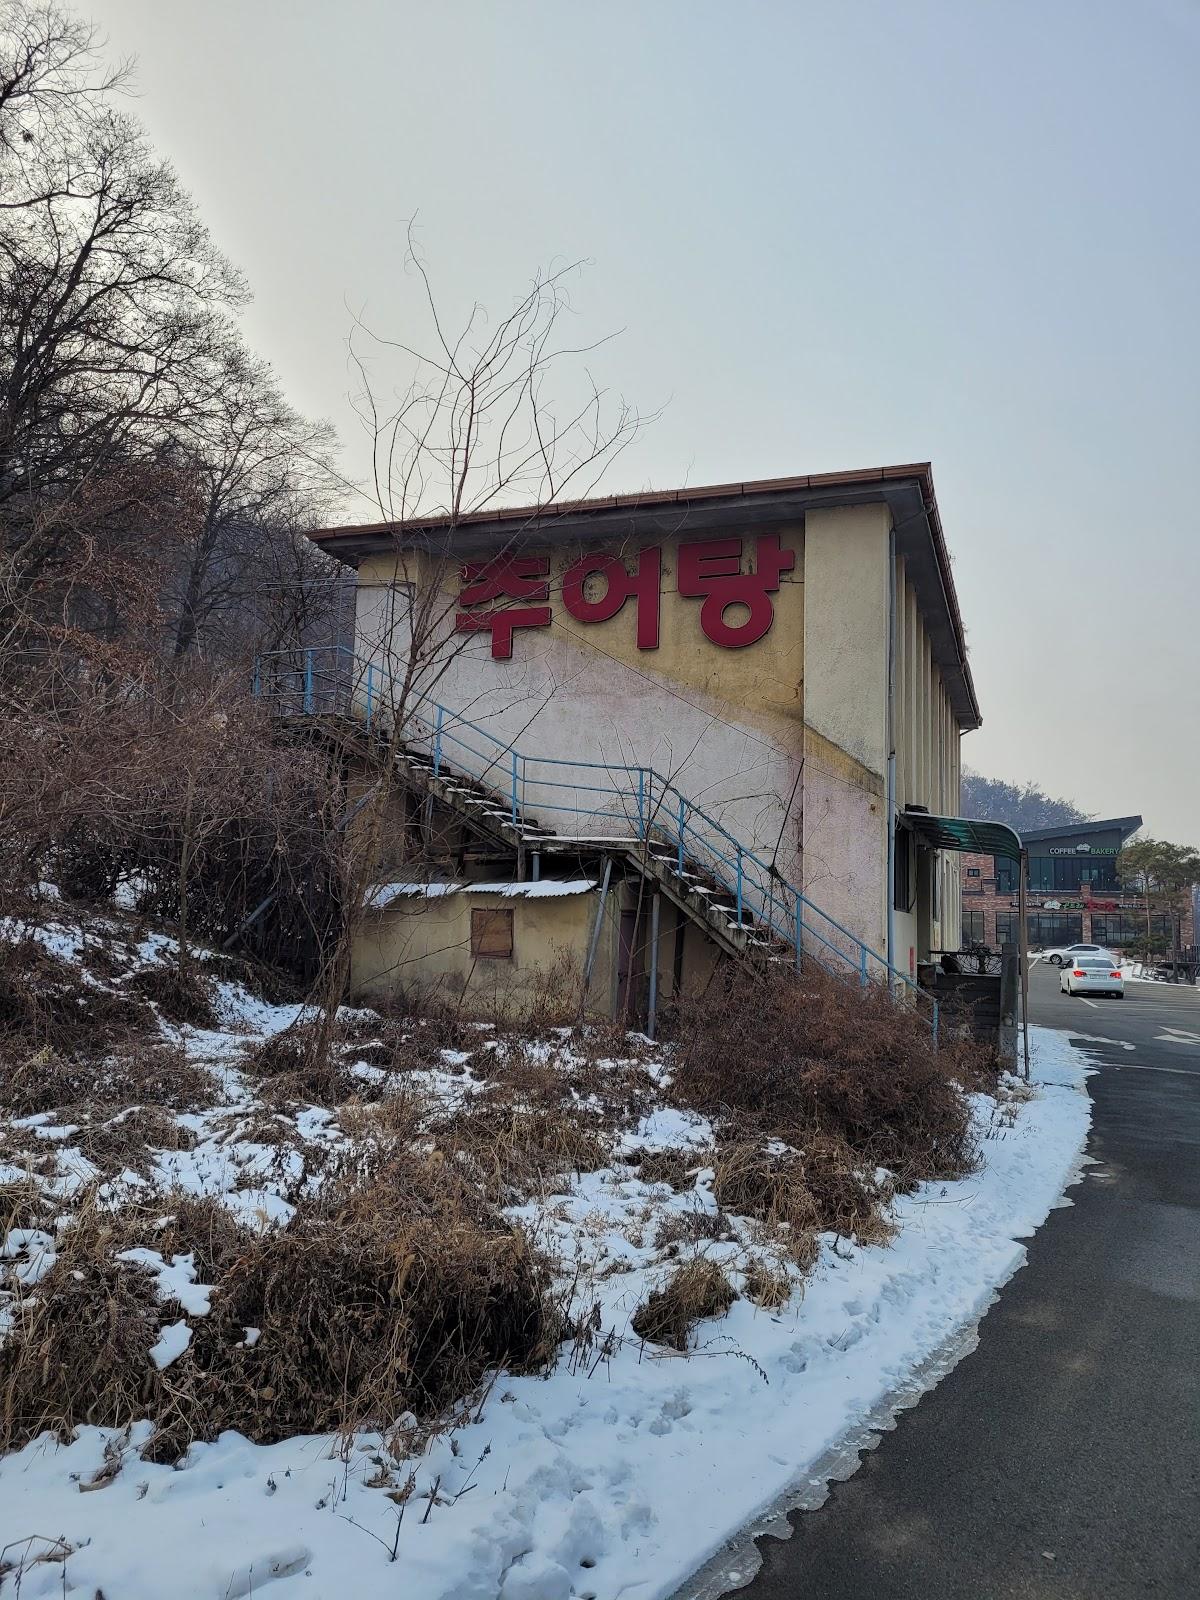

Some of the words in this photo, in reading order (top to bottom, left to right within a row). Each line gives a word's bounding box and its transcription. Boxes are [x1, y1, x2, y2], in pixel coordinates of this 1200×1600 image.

[456, 534, 795, 658] 추어탕
[1049, 847, 1077, 855] COFFEE
[1090, 847, 1119, 855] BAKERY
